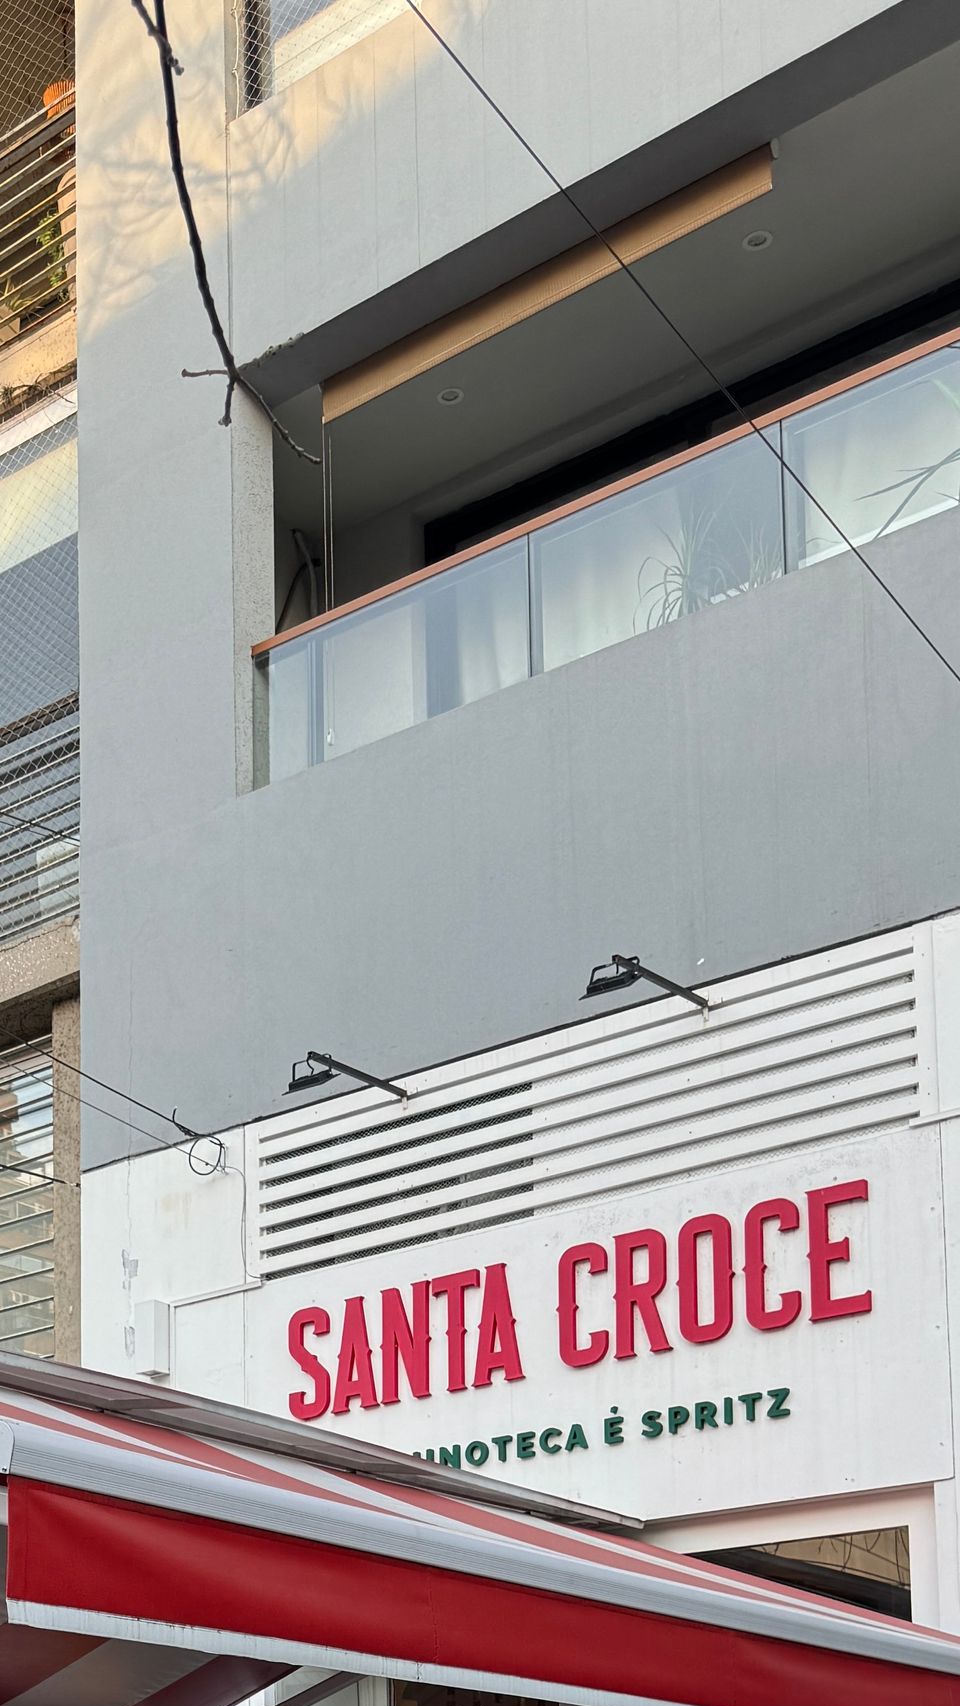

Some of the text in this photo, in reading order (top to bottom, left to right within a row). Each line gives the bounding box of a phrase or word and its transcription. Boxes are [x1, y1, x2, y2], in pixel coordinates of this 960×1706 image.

[288, 1178, 873, 1421] SANTA CROCE
[603, 1405, 625, 1446] É
[640, 1387, 792, 1439] SPRITZ
